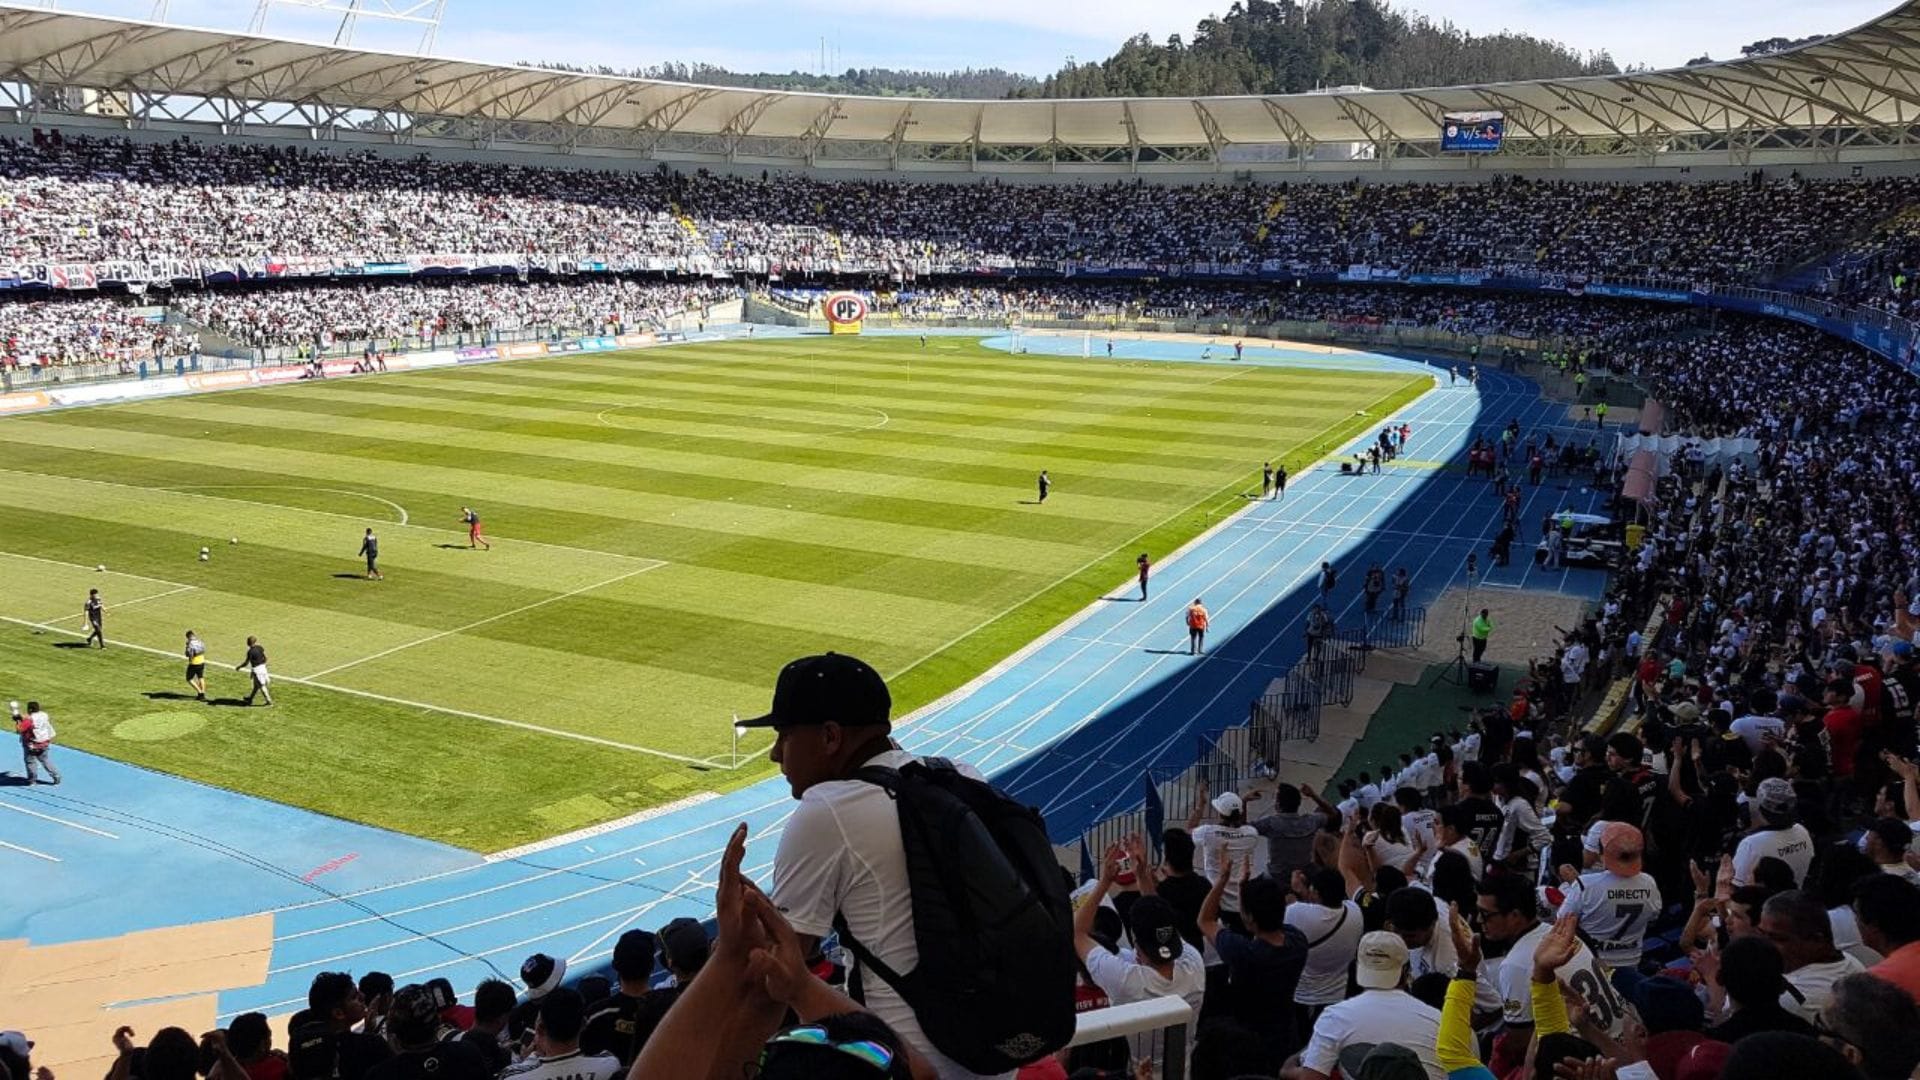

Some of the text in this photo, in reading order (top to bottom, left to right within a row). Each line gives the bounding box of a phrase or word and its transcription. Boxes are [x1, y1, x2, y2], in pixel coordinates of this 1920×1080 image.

[836, 299, 858, 319] PF
[1607, 889, 1651, 900] DIRECTV
[1615, 904, 1645, 940] 7
